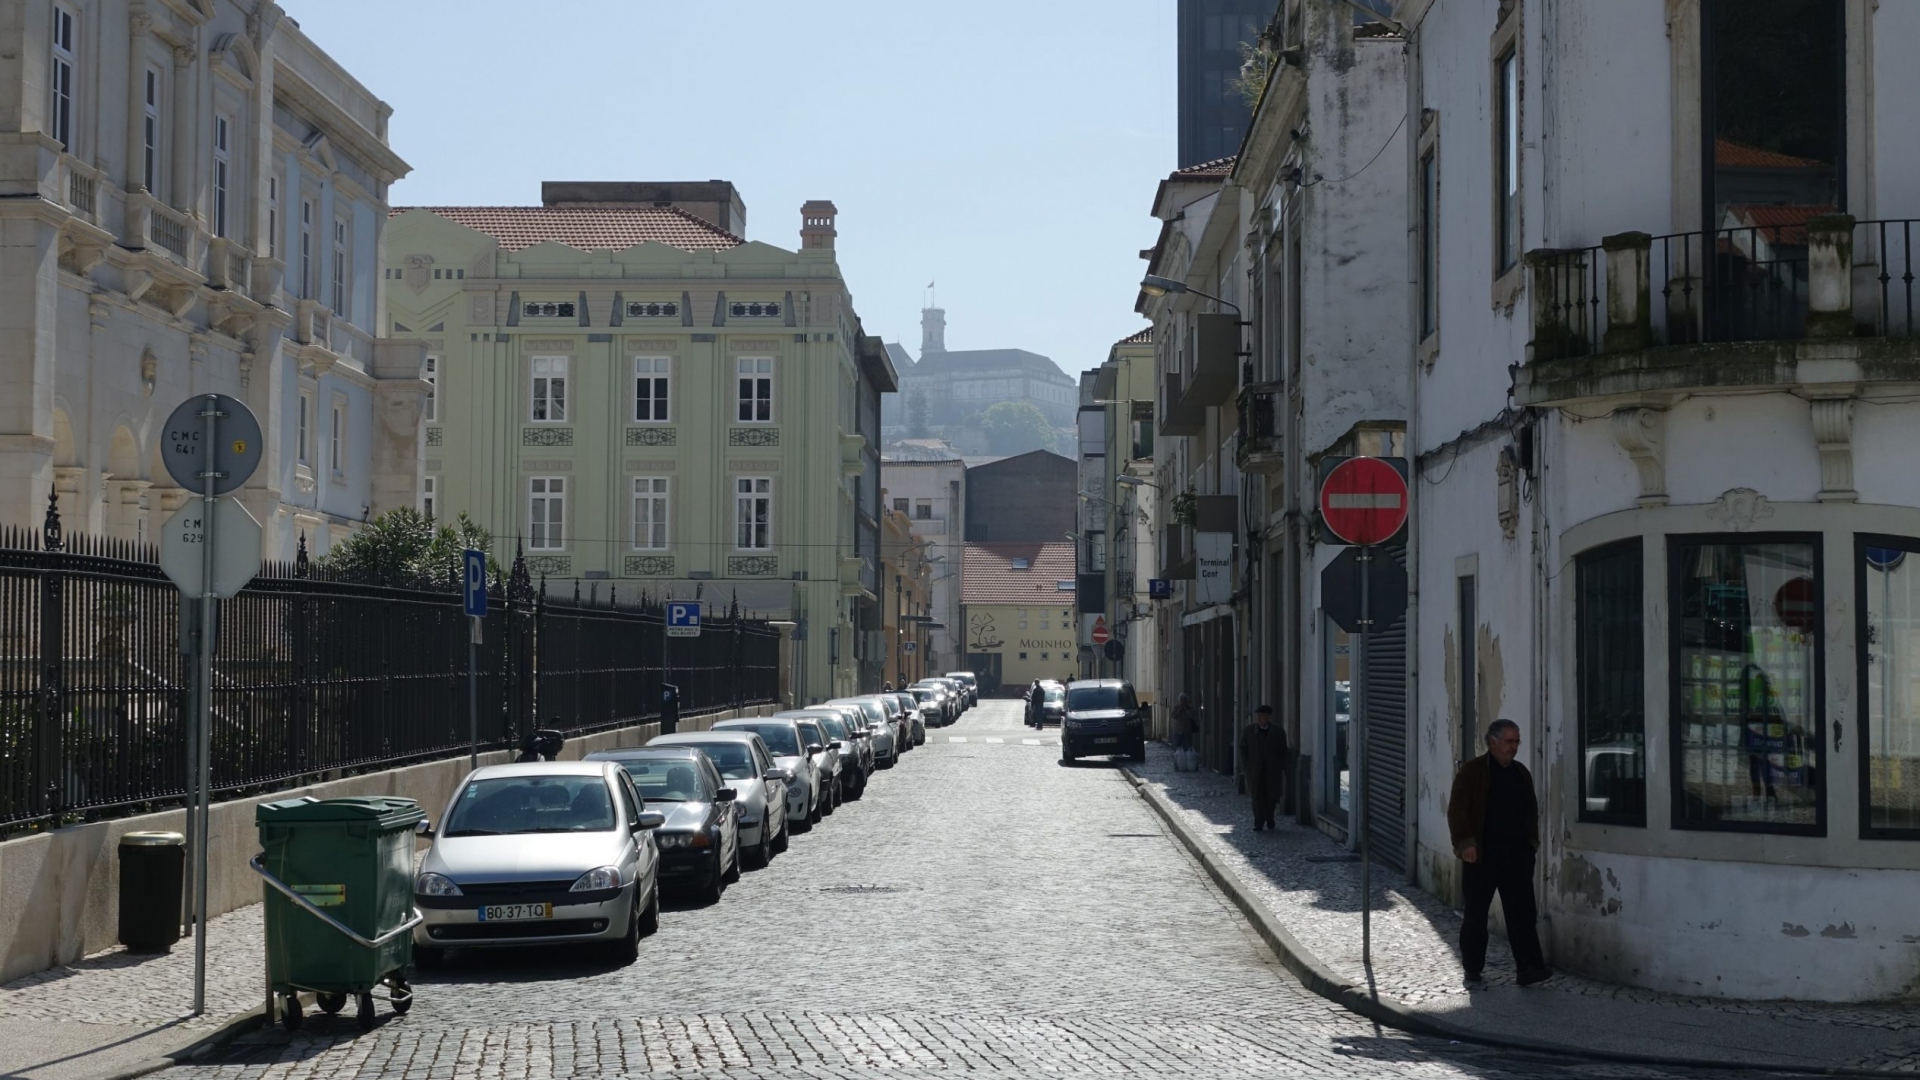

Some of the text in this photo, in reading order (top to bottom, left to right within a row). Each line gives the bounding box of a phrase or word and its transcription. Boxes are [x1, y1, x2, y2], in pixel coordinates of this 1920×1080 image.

[175, 444, 195, 455] 641
[182, 533, 203, 543] 629
[1200, 558, 1230, 567] Terminal
[1202, 569, 1218, 578] Cent
[469, 556, 482, 609] P
[1155, 581, 1165, 593] P
[672, 605, 687, 624] P
[1019, 638, 1072, 649] MOINHO
[664, 691, 670, 701] P
